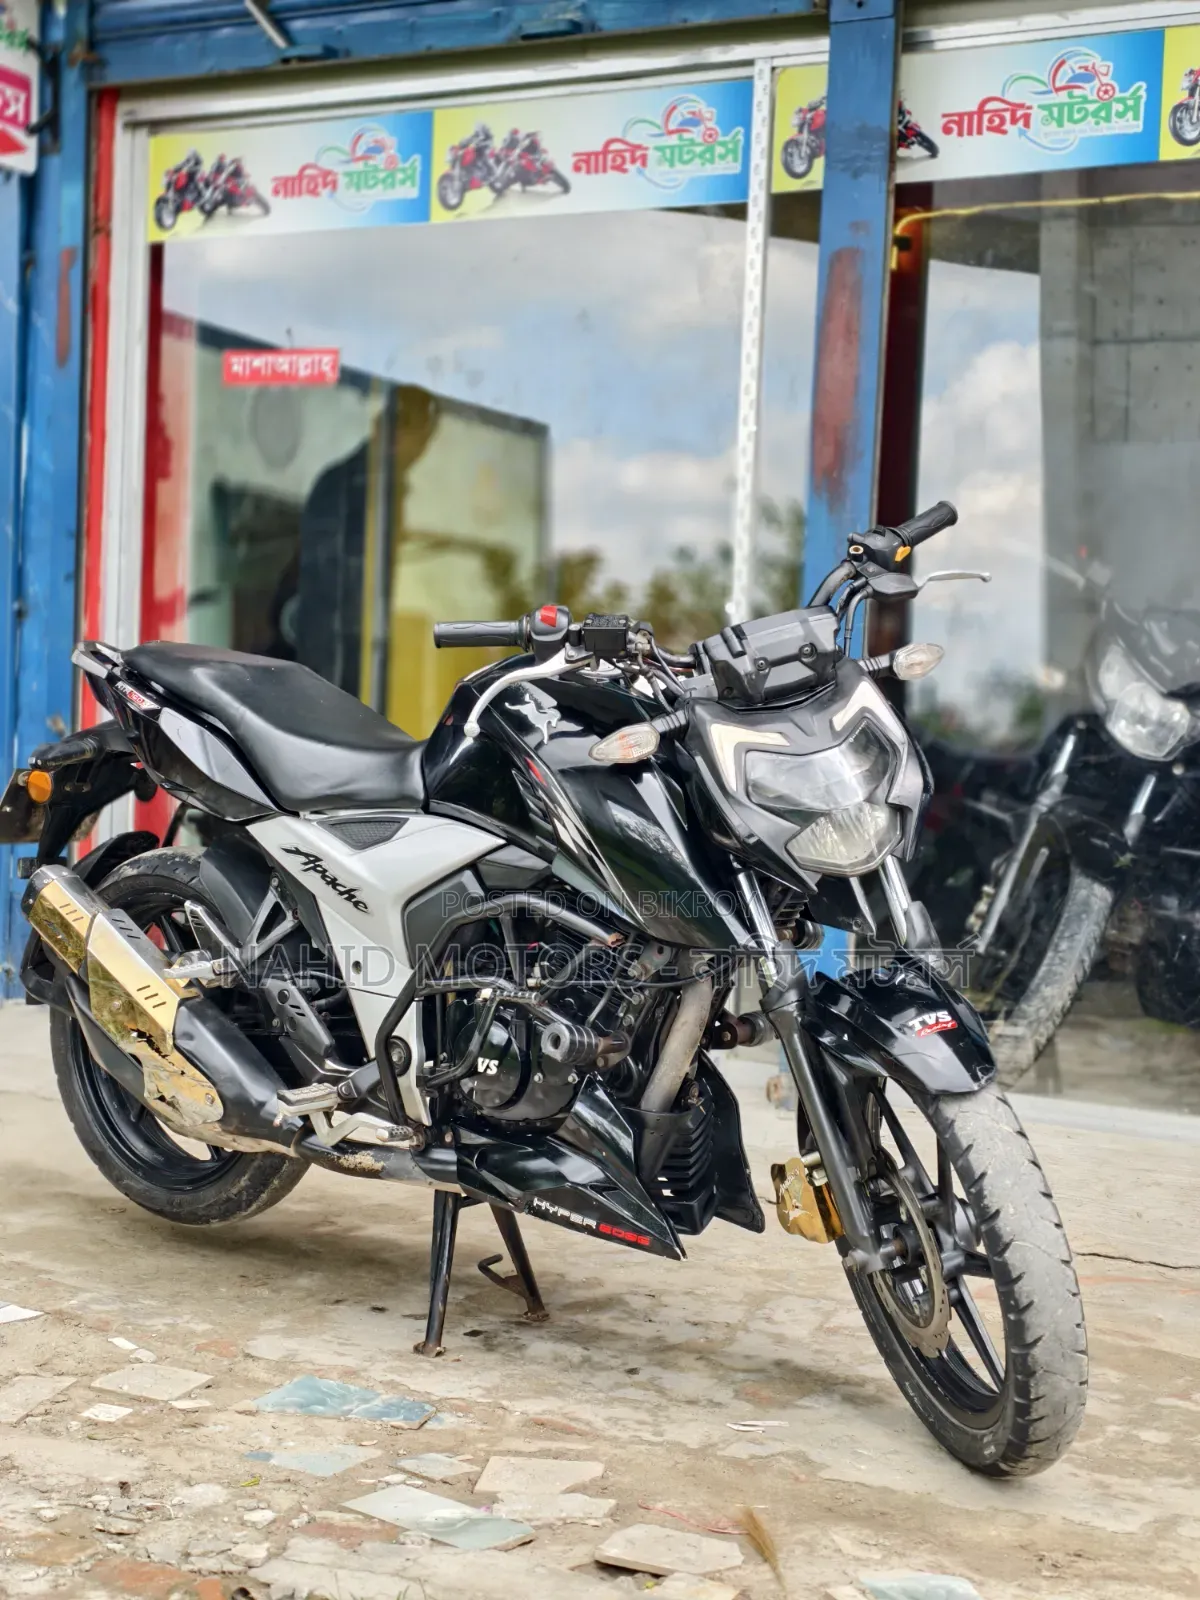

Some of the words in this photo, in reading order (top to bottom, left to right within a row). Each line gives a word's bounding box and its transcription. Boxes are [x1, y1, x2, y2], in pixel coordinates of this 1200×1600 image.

[941, 96, 1032, 138] নাহিদ
[572, 138, 649, 176] নাহিদ
[271, 162, 339, 200] নাহিদ
[279, 846, 371, 914] Apache
[908, 1010, 952, 1031] TVS
[477, 1057, 499, 1075] VS
[533, 1198, 597, 1229] HYPER
[599, 1223, 650, 1246] EDGE
